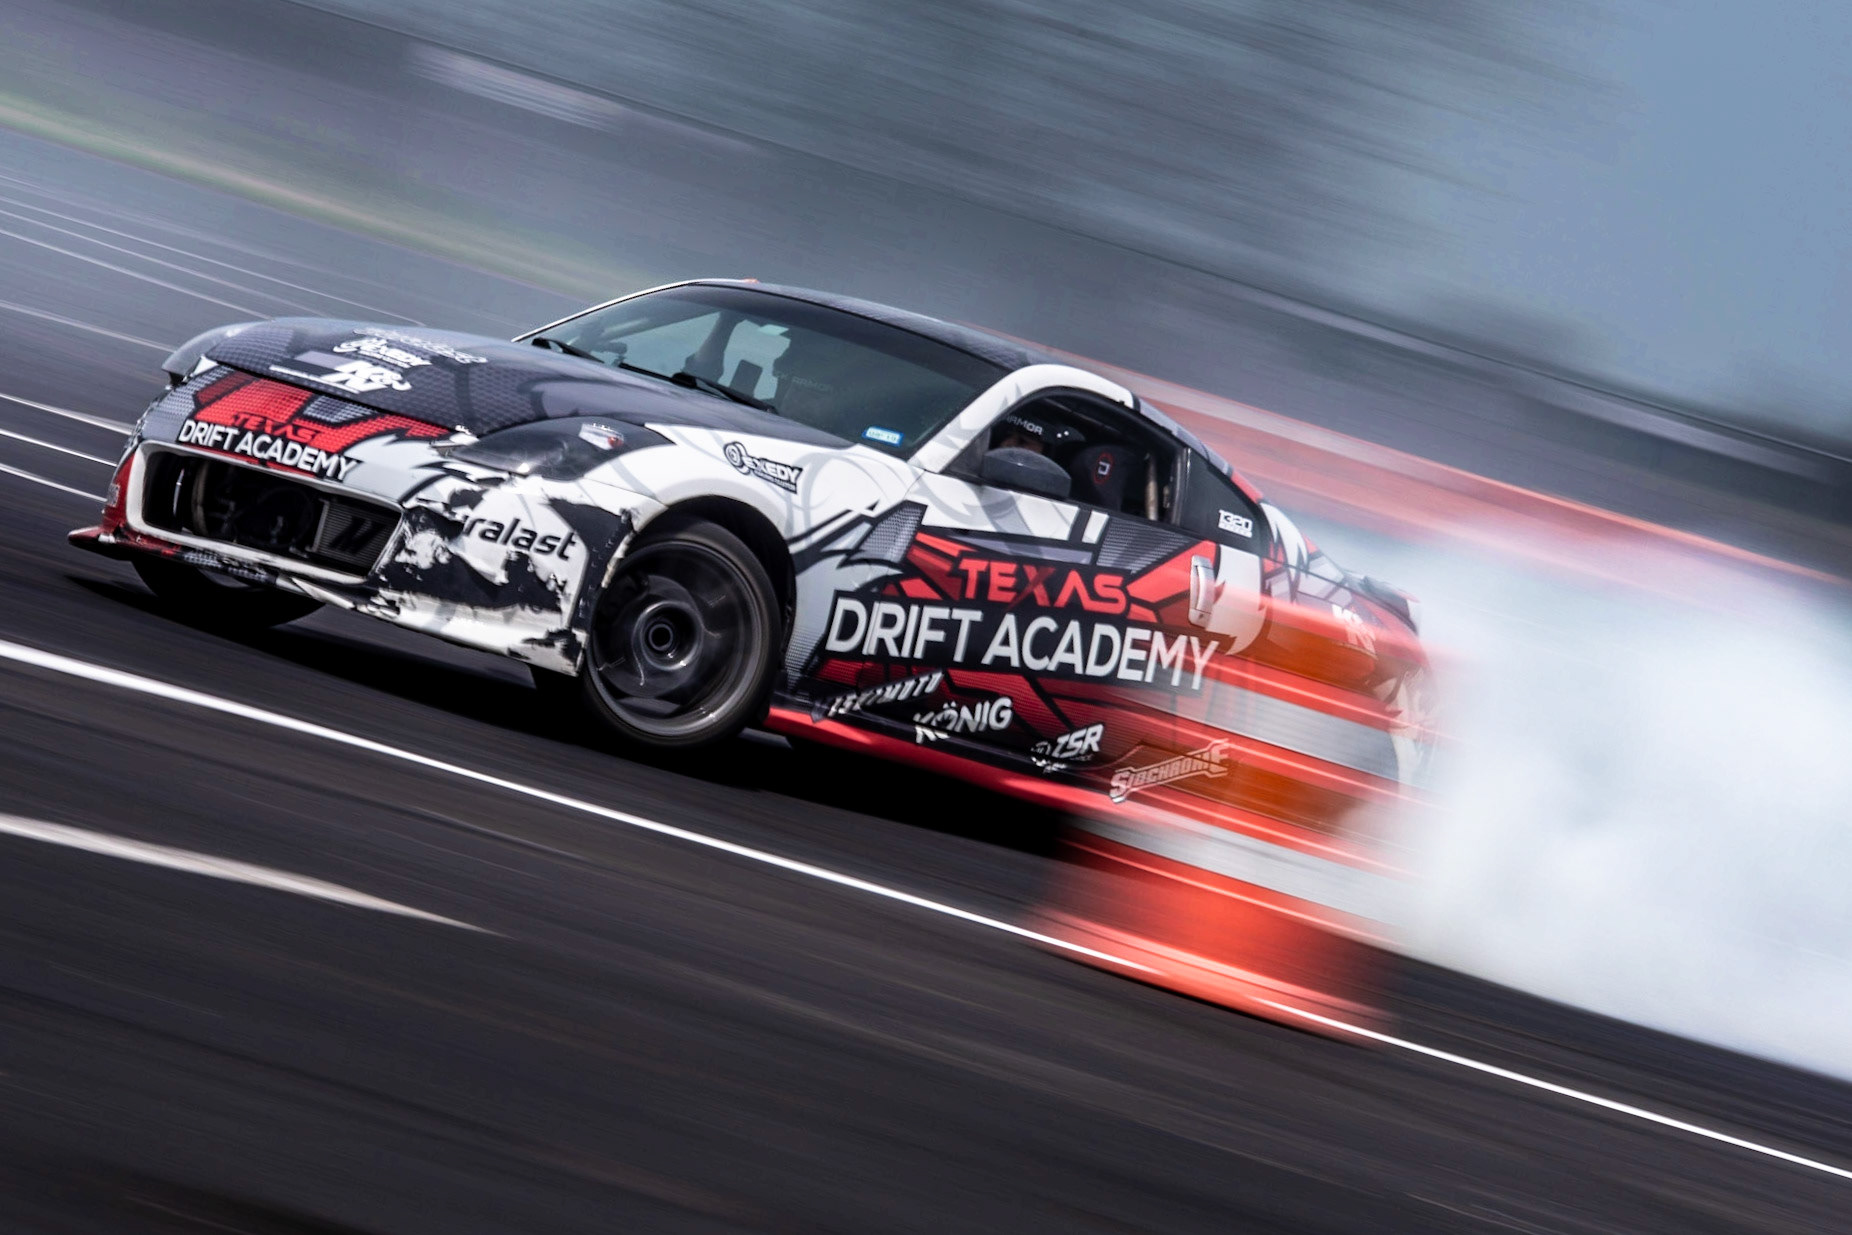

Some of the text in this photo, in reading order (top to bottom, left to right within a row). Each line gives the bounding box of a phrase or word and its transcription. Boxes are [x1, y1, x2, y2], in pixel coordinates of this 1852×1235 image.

[178, 420, 358, 481] DRIFT ACADEMY
[234, 413, 317, 443] TEXAS
[741, 456, 803, 485] EXEDY
[462, 513, 577, 562] ralast
[957, 557, 1128, 615] TEXAS
[825, 597, 1220, 691] DRIFT ACADEMY
[912, 696, 1013, 745] KÖNIG
